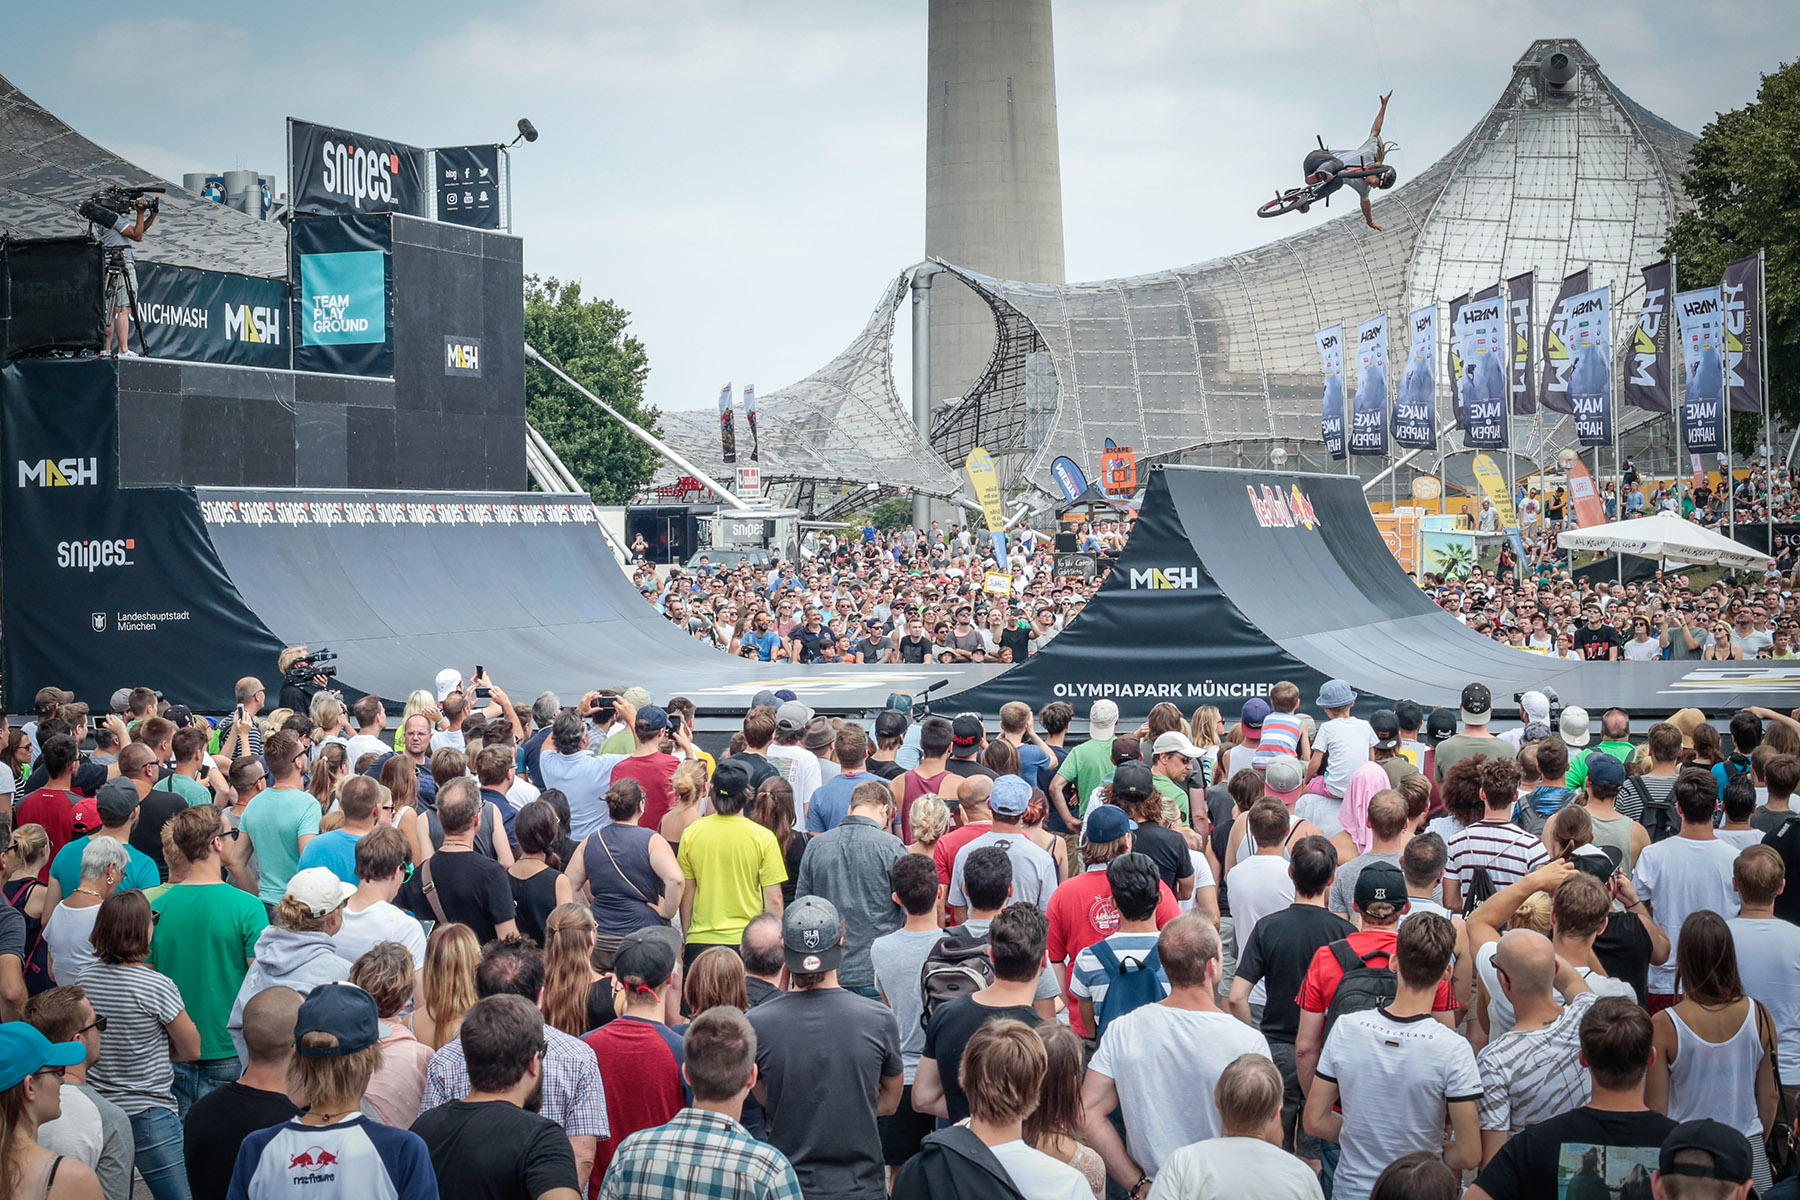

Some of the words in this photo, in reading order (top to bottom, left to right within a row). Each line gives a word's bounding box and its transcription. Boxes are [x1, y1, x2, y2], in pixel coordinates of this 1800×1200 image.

[322, 141, 392, 208] snipes
[313, 295, 350, 308] TEAM
[313, 308, 347, 321] PLAY
[225, 303, 280, 345] MASH
[313, 319, 368, 333] GROUND
[447, 344, 479, 370] MASH
[18, 457, 98, 488] MASH
[732, 523, 764, 538] snipes
[57, 539, 126, 573] snipes
[1130, 567, 1198, 589] MASH
[117, 611, 190, 621] Landeshauptstadt
[117, 622, 157, 631] München
[1053, 683, 1183, 697] OLYMPIAPARK
[803, 929, 819, 938] SLS
[1359, 1021, 1434, 1040] DEUTSCHLAND
